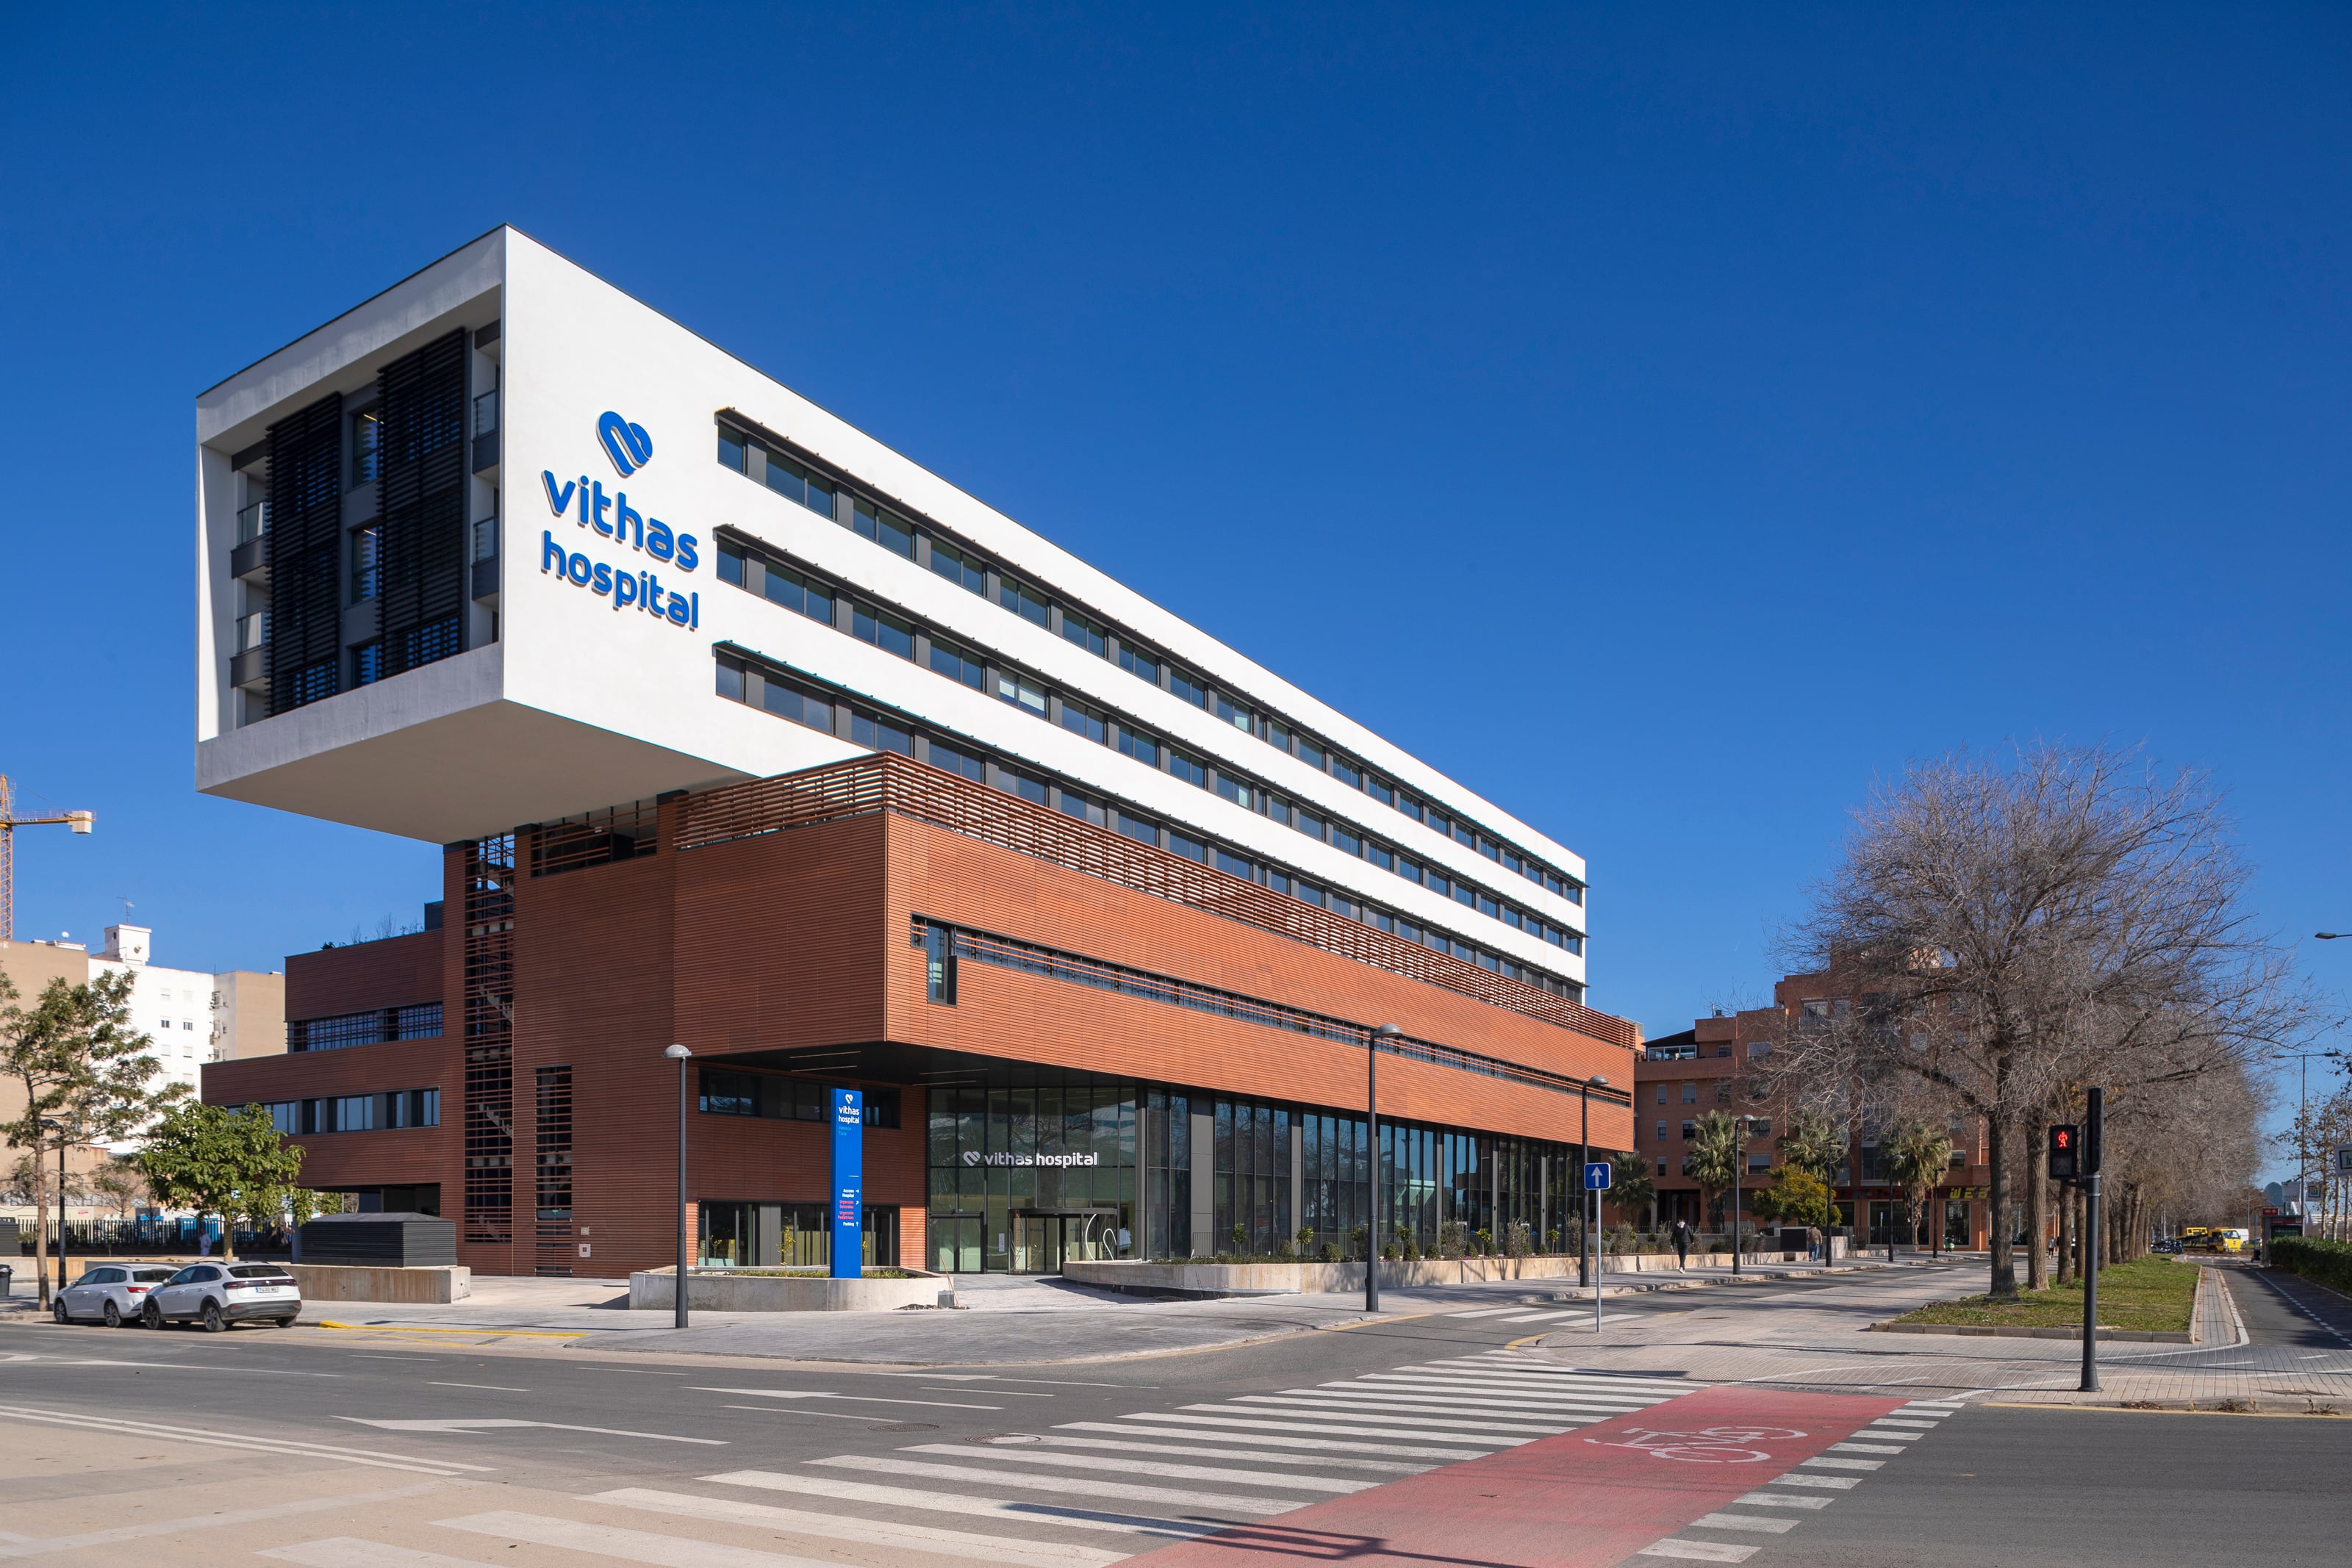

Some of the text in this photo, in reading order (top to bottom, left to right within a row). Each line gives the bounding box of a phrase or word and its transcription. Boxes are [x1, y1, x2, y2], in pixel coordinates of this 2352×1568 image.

[541, 470, 698, 572] vithas
[541, 530, 698, 632] hospital
[838, 1105, 860, 1115] vithas
[838, 1115, 860, 1124] hospital
[984, 1151, 1098, 1168] vithas hospital
